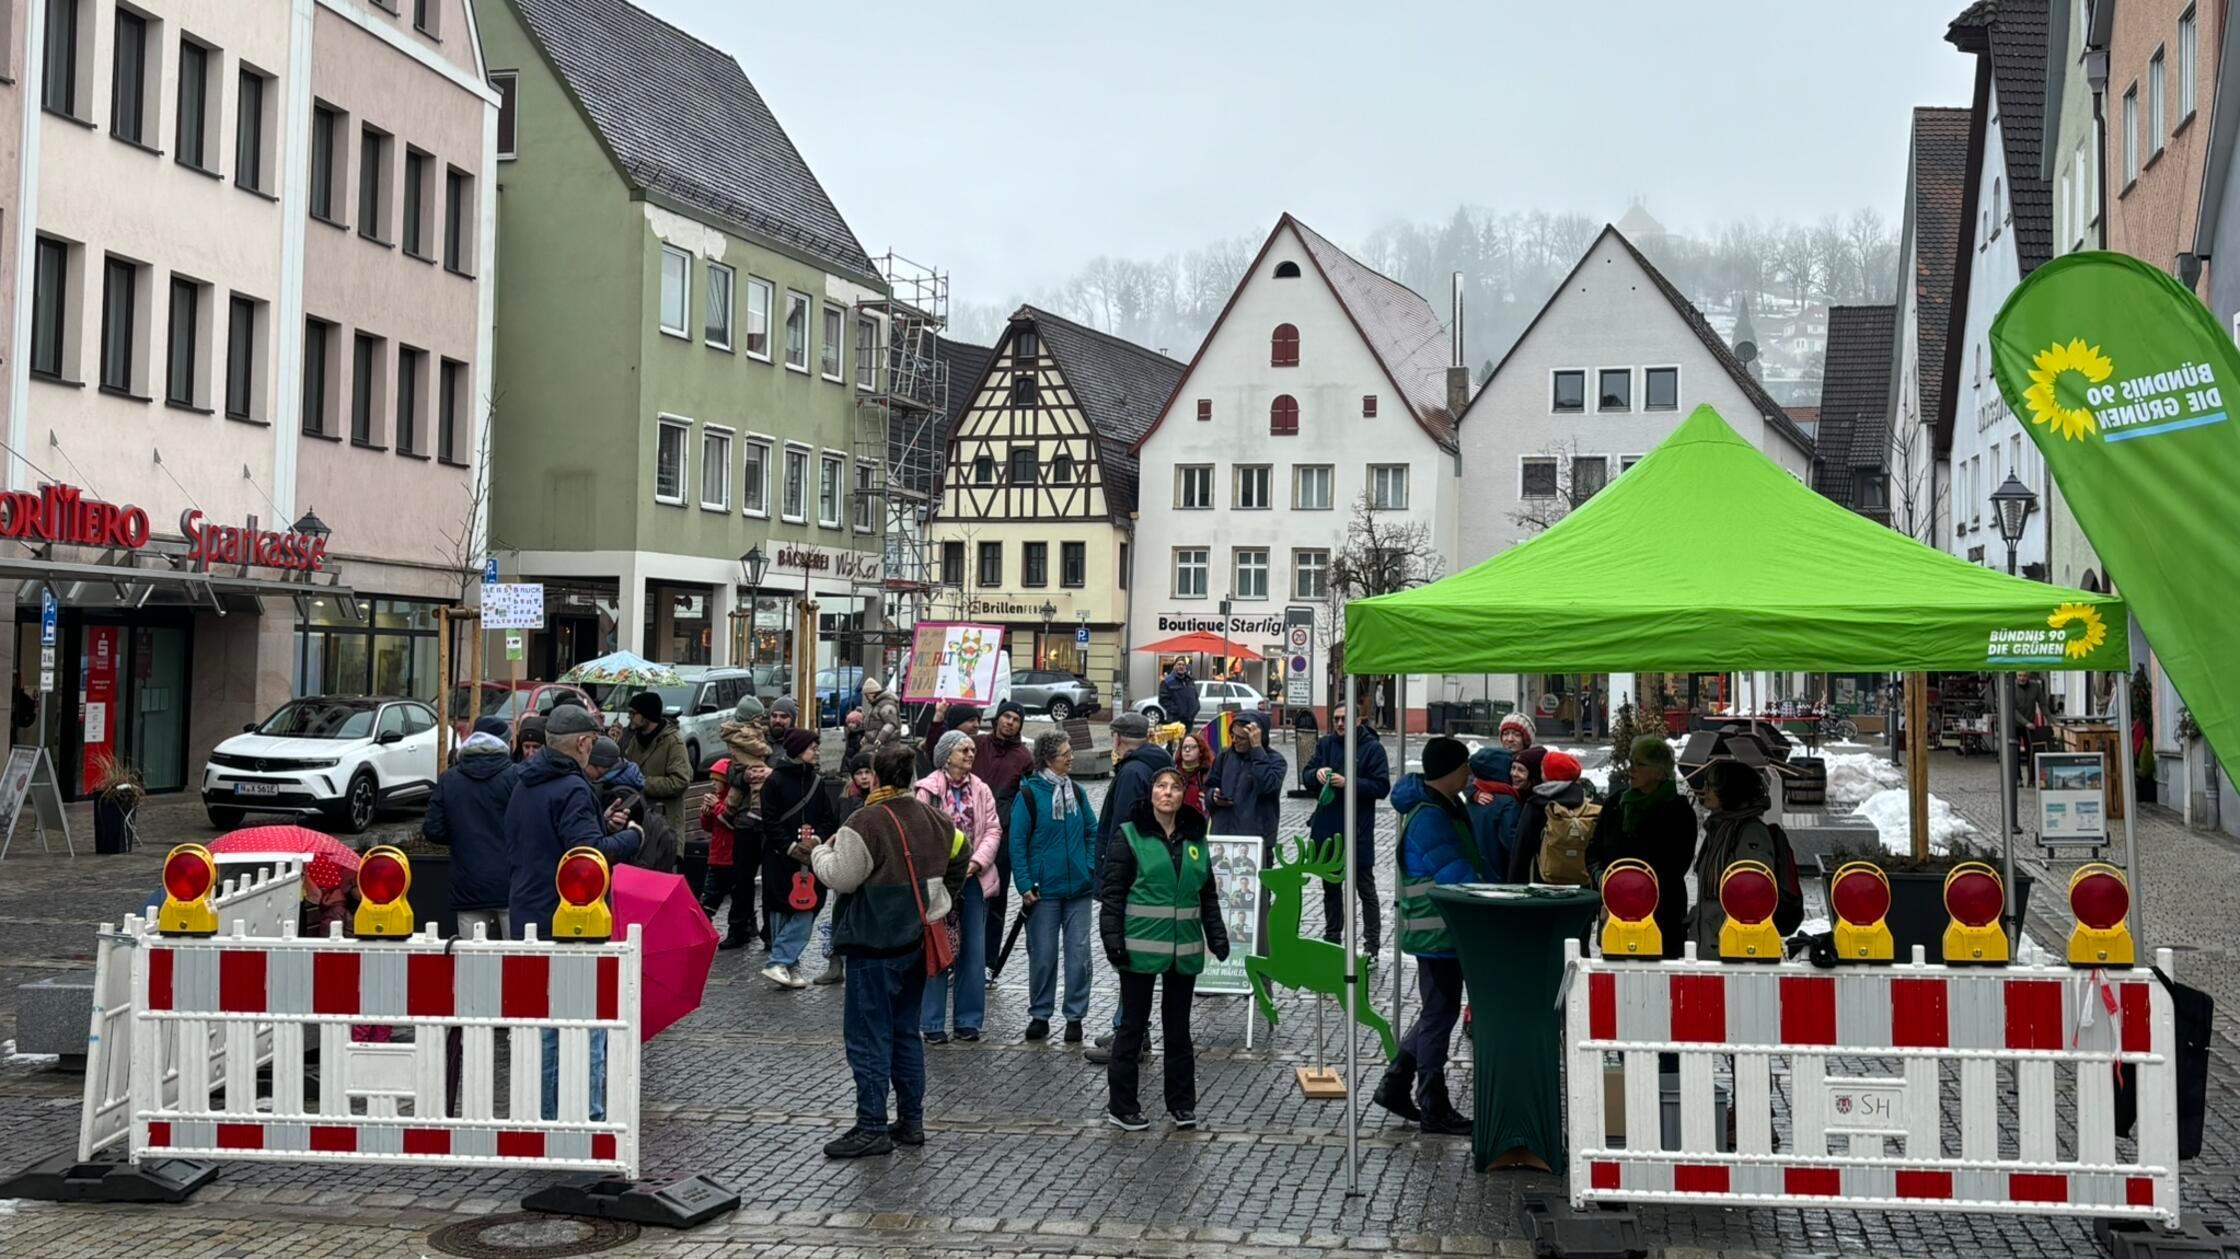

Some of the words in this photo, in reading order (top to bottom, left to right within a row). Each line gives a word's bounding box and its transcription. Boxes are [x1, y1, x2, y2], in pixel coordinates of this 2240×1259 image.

[181, 508, 327, 573] Sparkasse
[1158, 617, 1225, 632] Boutique
[1989, 628, 2046, 642] BÜNDNIS
[2048, 630, 2066, 641] 90
[1988, 643, 2009, 655] DIE
[2012, 640, 2065, 655] GRÜNEN
[1860, 1093, 1890, 1119] SH
